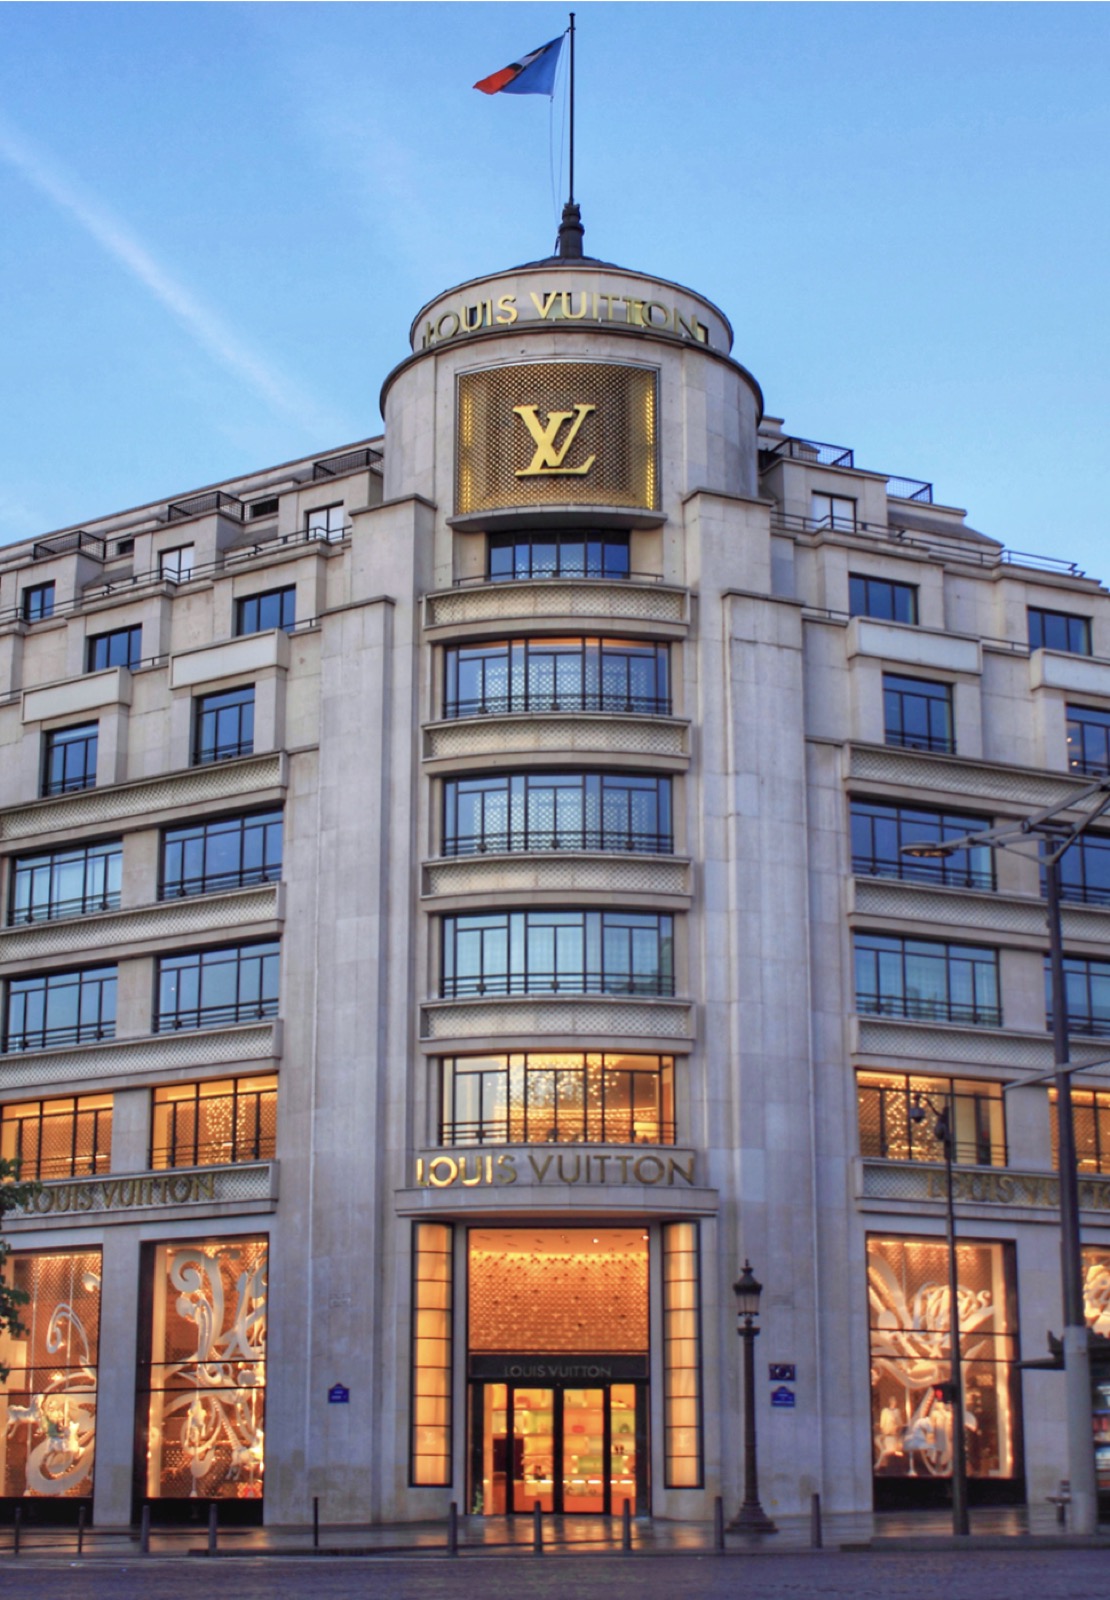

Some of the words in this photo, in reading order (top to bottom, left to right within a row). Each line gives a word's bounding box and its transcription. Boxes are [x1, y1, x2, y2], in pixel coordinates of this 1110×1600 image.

[424, 294, 518, 348] LOUIS
[530, 290, 699, 342] VUITTON
[417, 1155, 518, 1187] LOUIS
[528, 1155, 695, 1186] VUITTON
[98, 1174, 216, 1209] VUITTON
[503, 1365, 546, 1378] LOUIS
[548, 1365, 612, 1378] VUITTON
